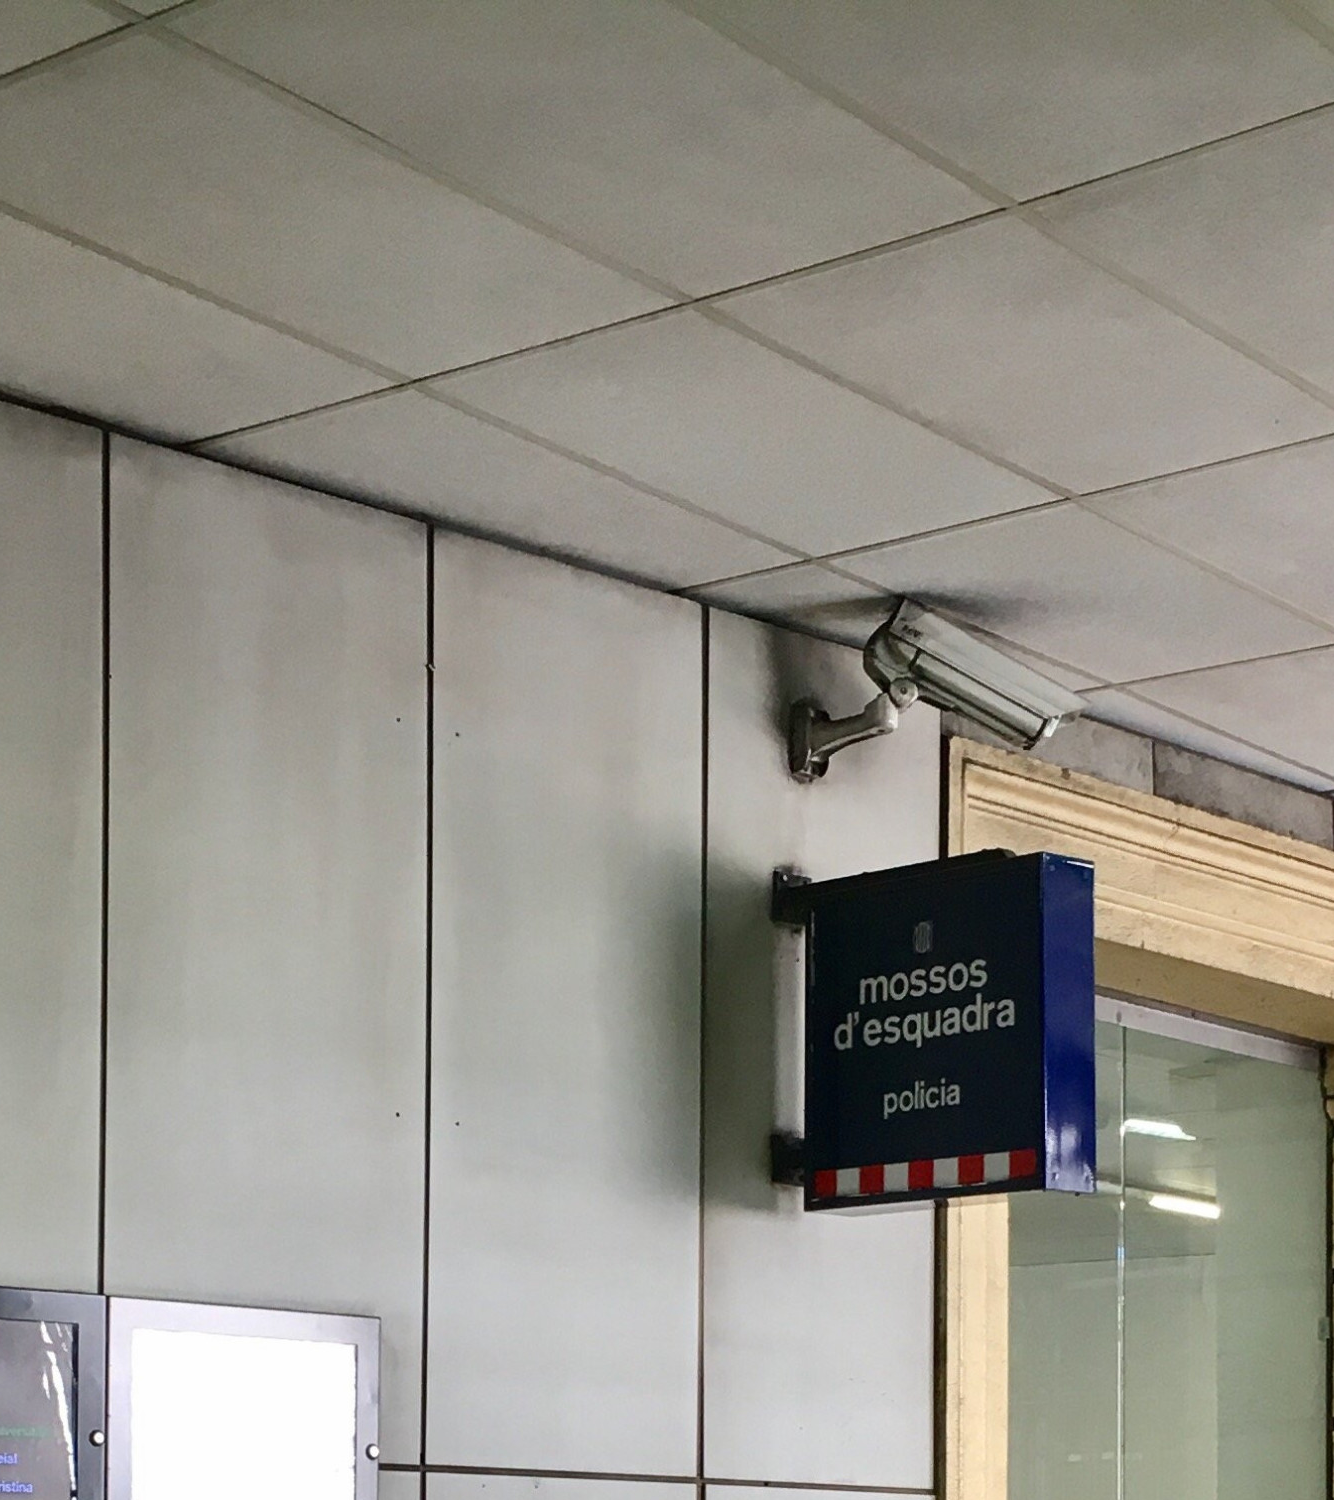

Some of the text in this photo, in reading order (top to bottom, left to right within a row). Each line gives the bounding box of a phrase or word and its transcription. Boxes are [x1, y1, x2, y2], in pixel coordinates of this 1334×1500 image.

[859, 958, 988, 1005] mossos
[834, 993, 1016, 1050] d'esquadra
[883, 1078, 961, 1119] policia
